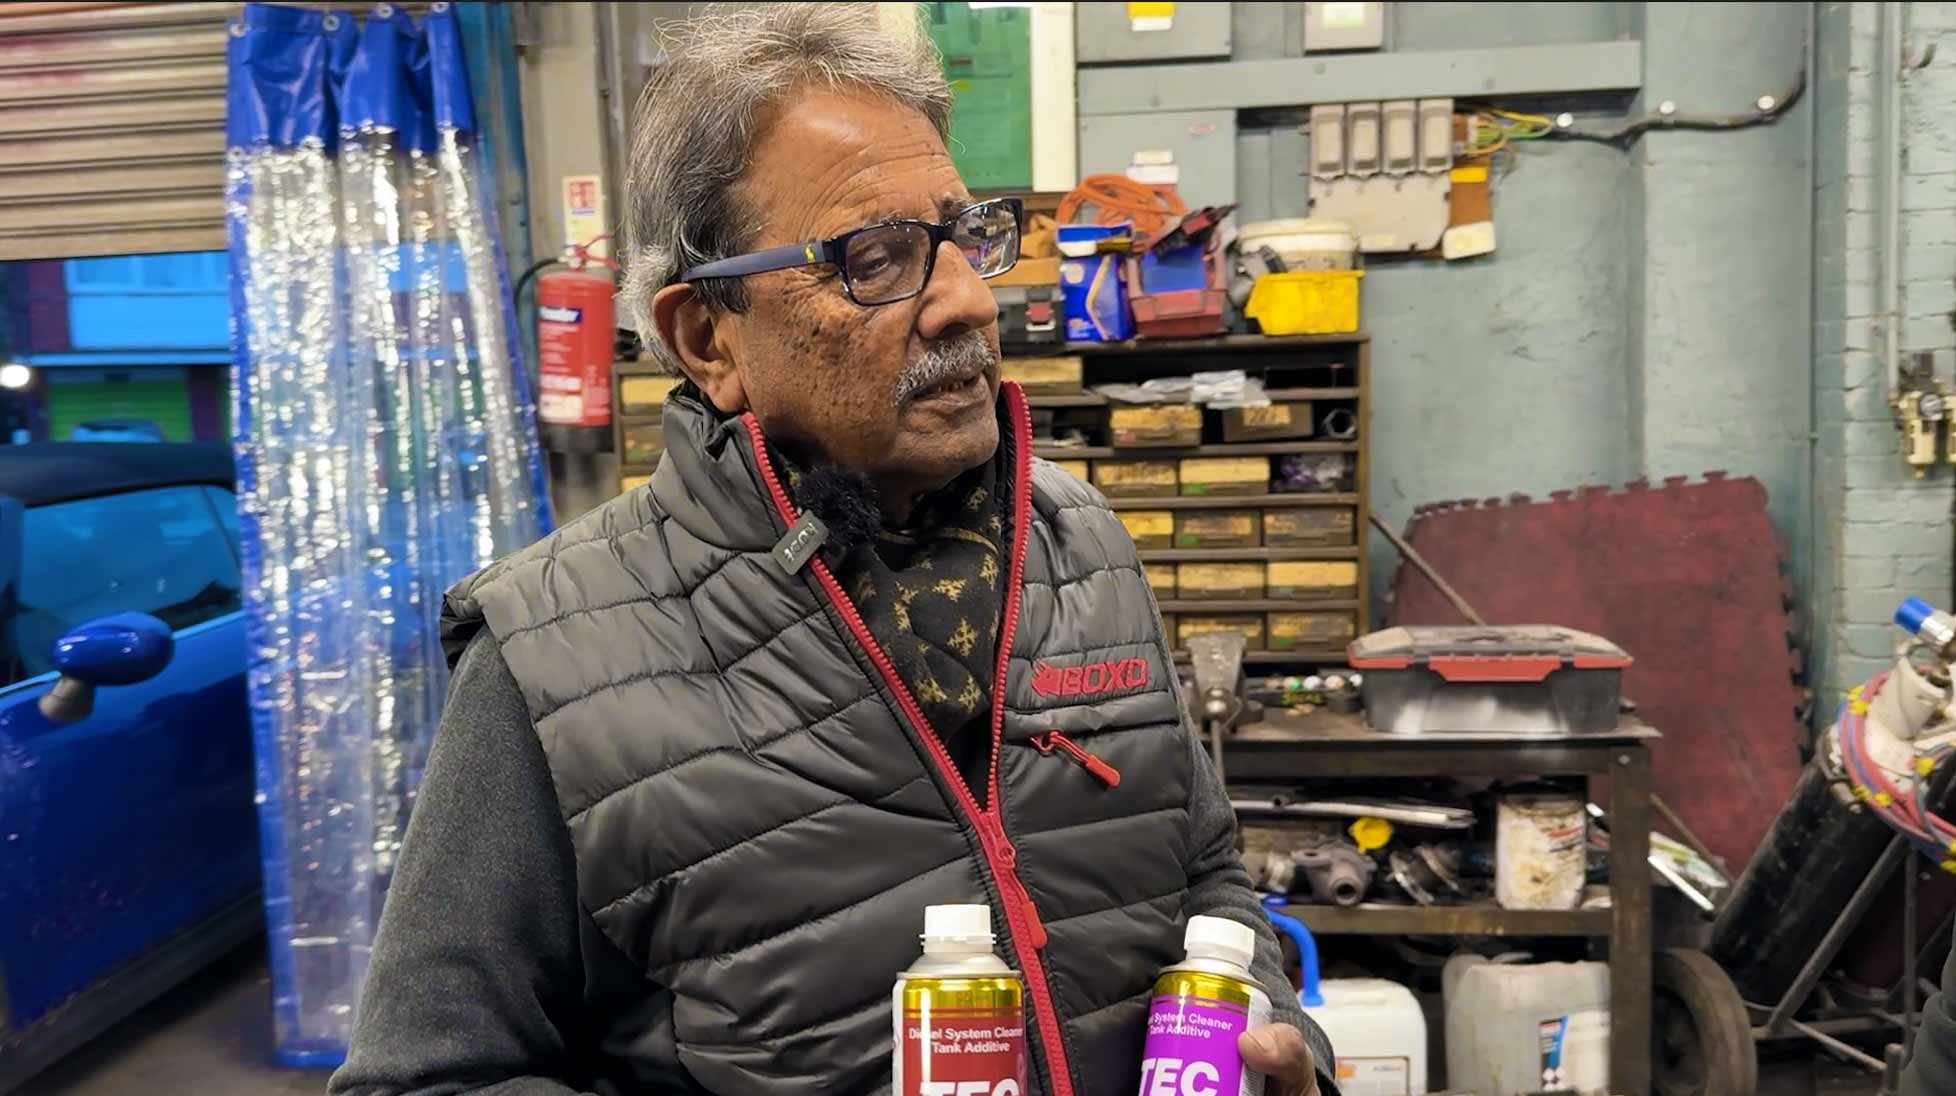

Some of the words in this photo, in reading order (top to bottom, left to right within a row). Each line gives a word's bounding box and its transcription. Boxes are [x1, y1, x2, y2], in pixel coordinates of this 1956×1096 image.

[1062, 657, 1147, 696] BOXO
[1188, 1013, 1233, 1031] Cleaner
[908, 1027, 943, 1039] Diel
[945, 1027, 992, 1042] System
[1166, 1024, 1211, 1039] Additive
[931, 1042, 962, 1053] Tank
[963, 1041, 1010, 1053] Additive
